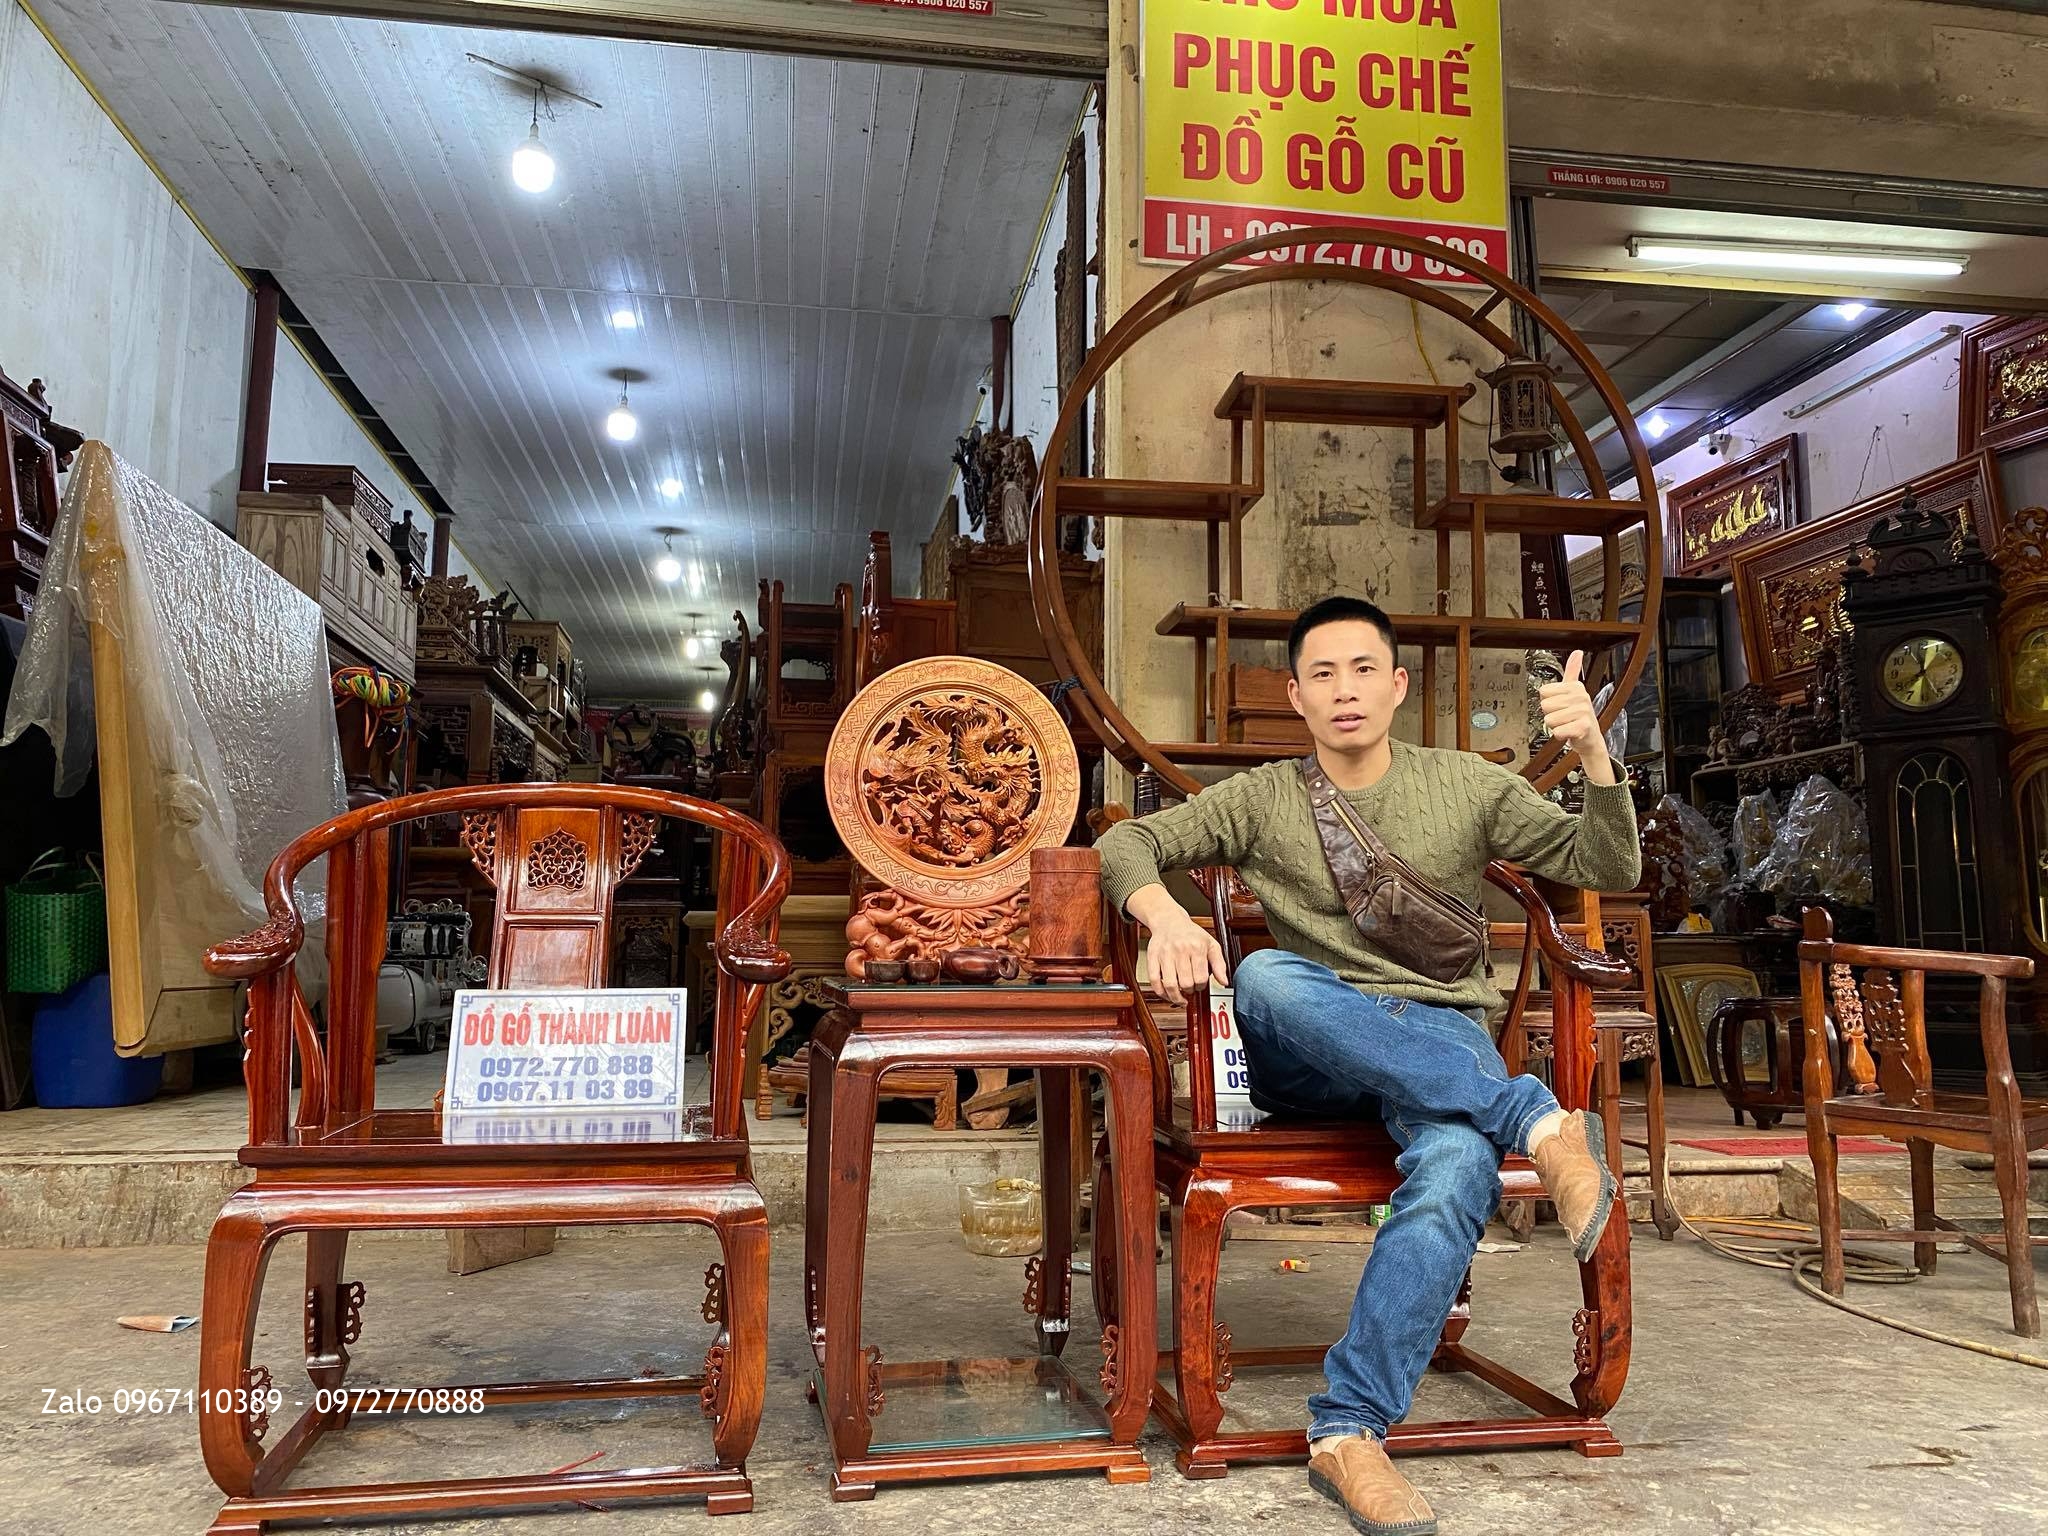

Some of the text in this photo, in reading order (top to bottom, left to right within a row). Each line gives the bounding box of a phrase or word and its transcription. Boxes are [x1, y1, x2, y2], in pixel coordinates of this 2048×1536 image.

[968, 0, 988, 11] 557
[1173, 32, 1476, 117] PHỤC CHẾ
[1180, 109, 1464, 203] ĐỒ GỖ CŨ
[1630, 178, 1647, 188] 020
[1648, 180, 1666, 190] 557
[1166, 213, 1211, 256] LH
[463, 1001, 672, 1046] ĐỒ GỖ THÀNH LUÂN
[480, 1054, 653, 1078] 0972.770 888
[477, 1078, 654, 1102] 0967.11 03 89
